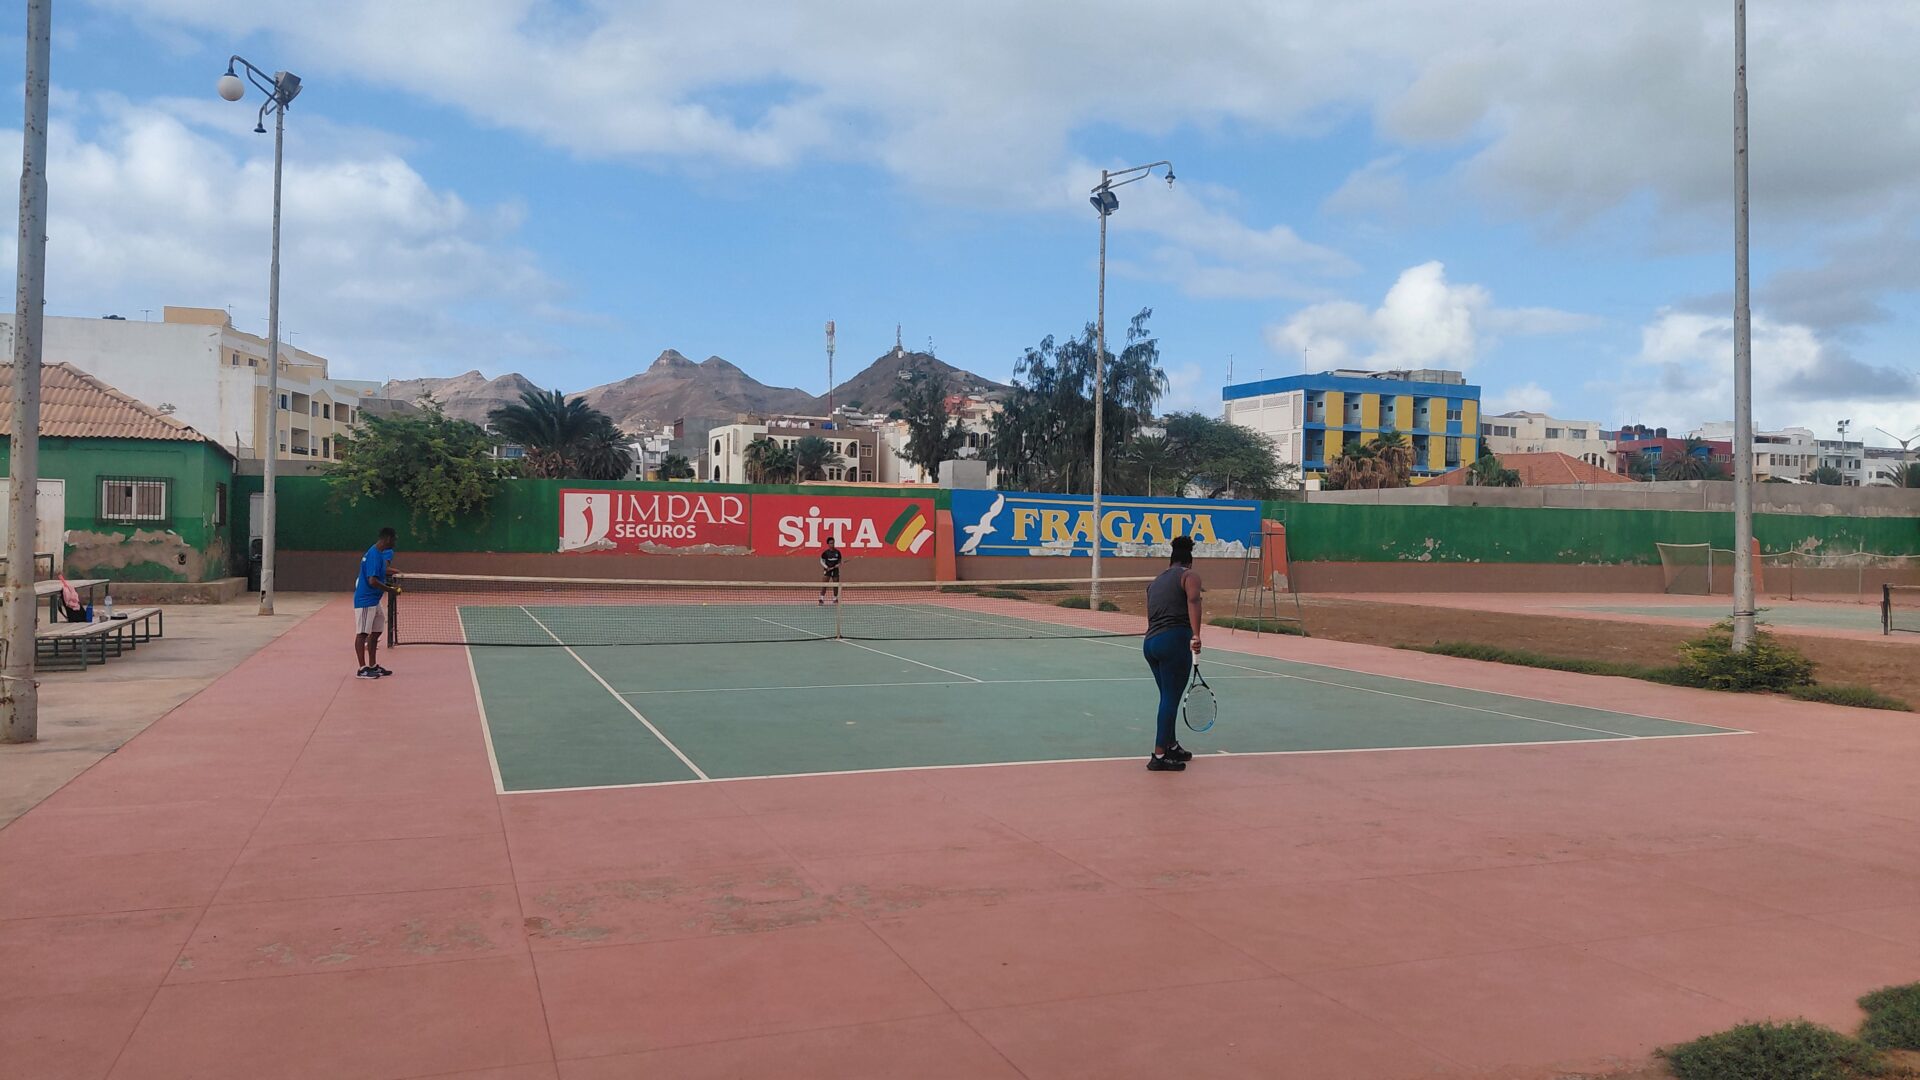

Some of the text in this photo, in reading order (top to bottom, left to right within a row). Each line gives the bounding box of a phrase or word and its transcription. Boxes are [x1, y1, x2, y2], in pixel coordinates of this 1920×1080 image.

[616, 494, 745, 524] IMPAR
[615, 523, 696, 538] SEGUROS
[1011, 508, 1218, 544] FRAGATA
